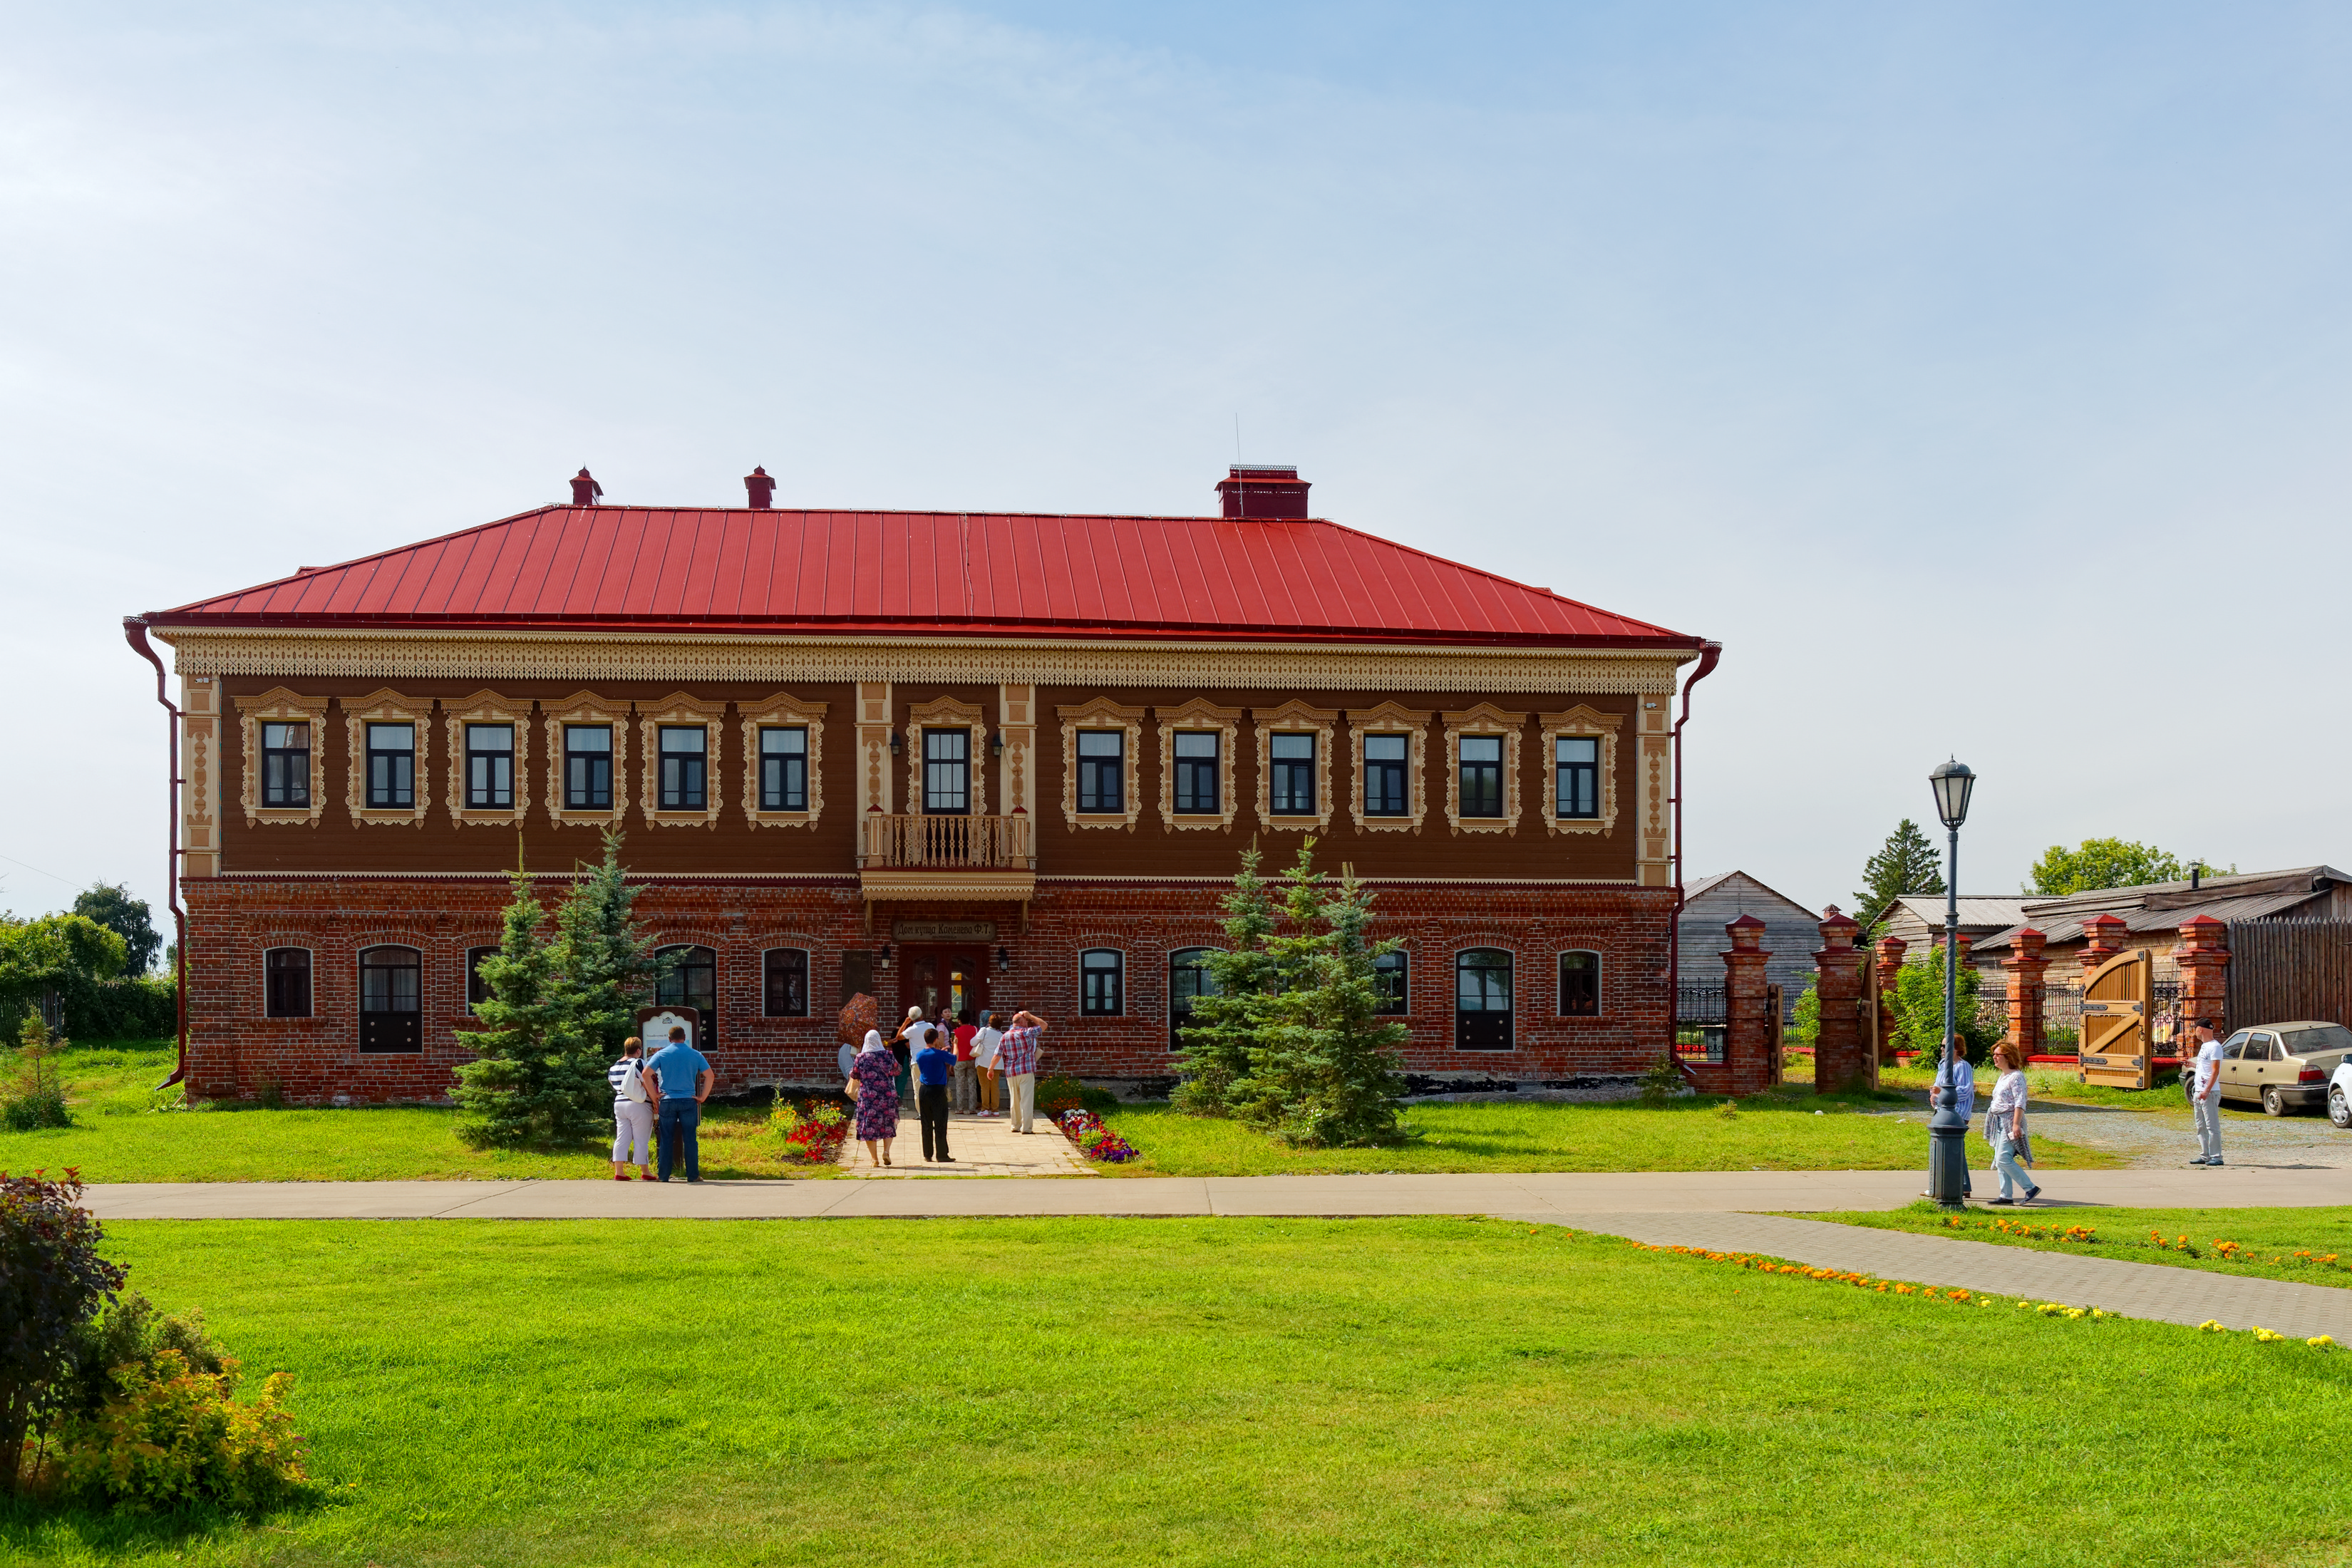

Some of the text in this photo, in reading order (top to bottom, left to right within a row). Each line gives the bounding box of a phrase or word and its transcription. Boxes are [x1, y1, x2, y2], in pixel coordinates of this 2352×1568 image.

[898, 924, 991, 936] Дом купца Каменева Ф.Т.
